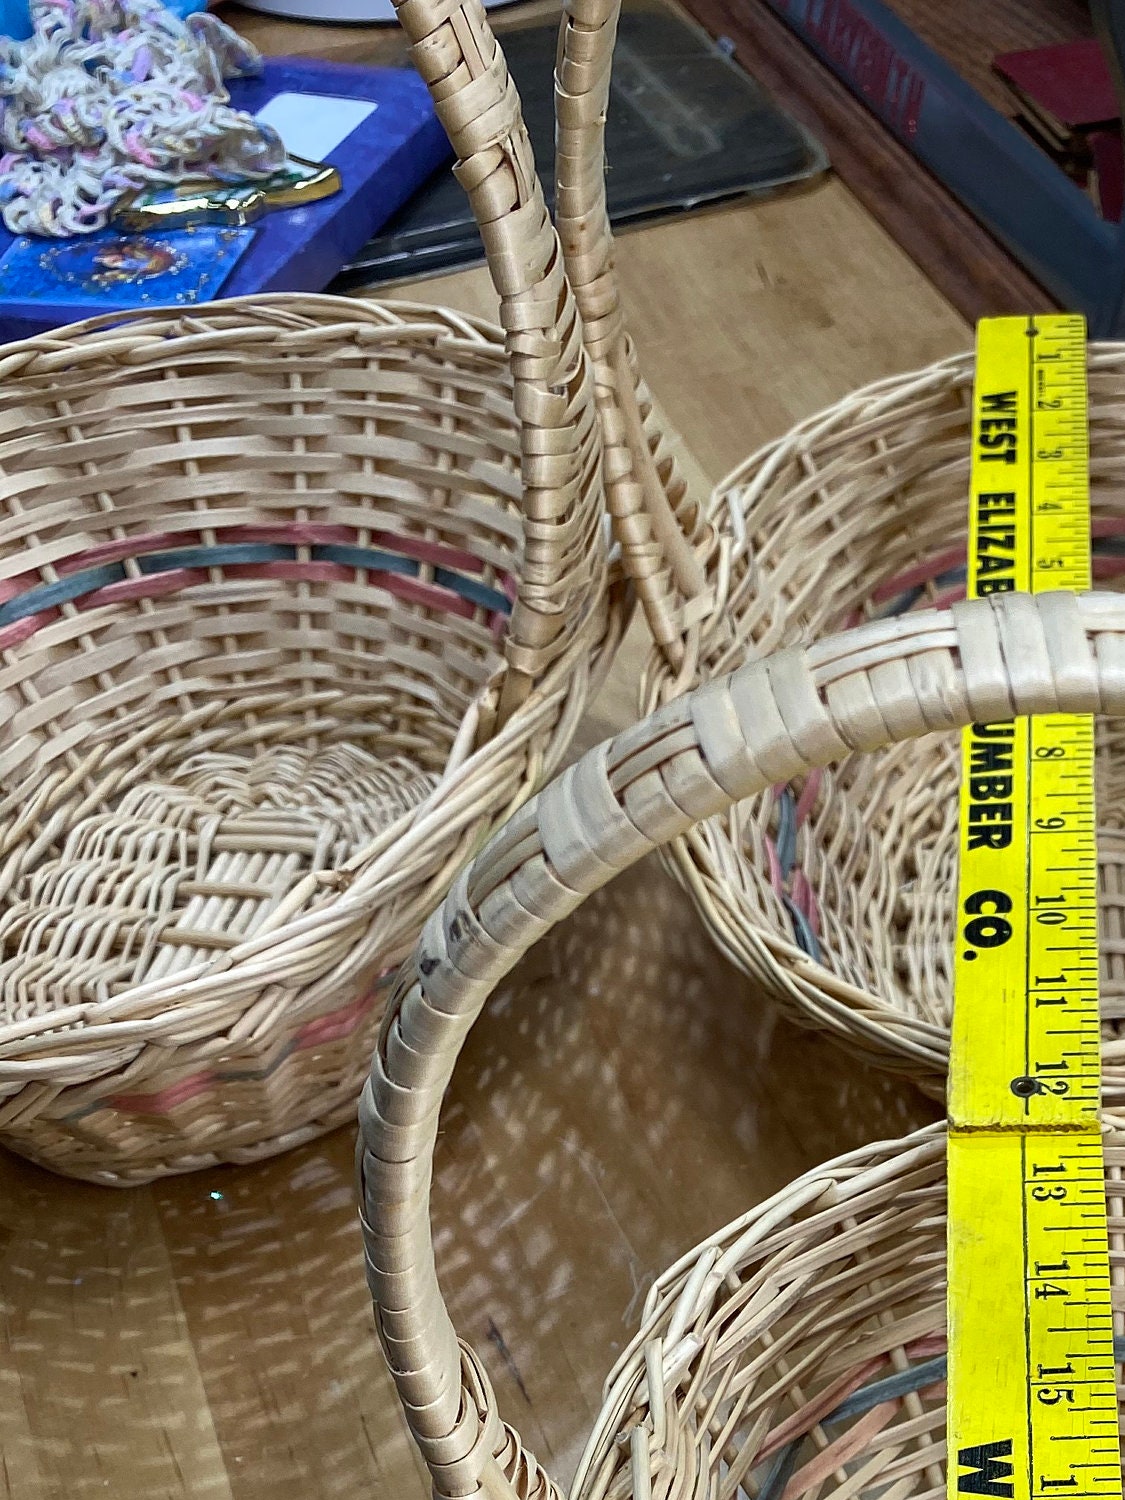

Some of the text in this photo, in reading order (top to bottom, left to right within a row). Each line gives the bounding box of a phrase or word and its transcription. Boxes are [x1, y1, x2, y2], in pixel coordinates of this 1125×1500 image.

[1038, 399, 1061, 409] 2
[979, 390, 1018, 464] WEST
[1037, 450, 1063, 459] 3
[1037, 502, 1063, 511] 4
[1038, 559, 1064, 569] 5
[1035, 747, 1065, 758] 8
[1035, 817, 1066, 830] 9
[963, 889, 1013, 961] CO.
[1035, 895, 1067, 925] 10
[1035, 974, 1068, 1008] 11
[1035, 1060, 1069, 1096] 12
[1031, 1163, 1067, 1201] 13
[1034, 1260, 1071, 1301] 14
[1036, 1362, 1076, 1405] 15
